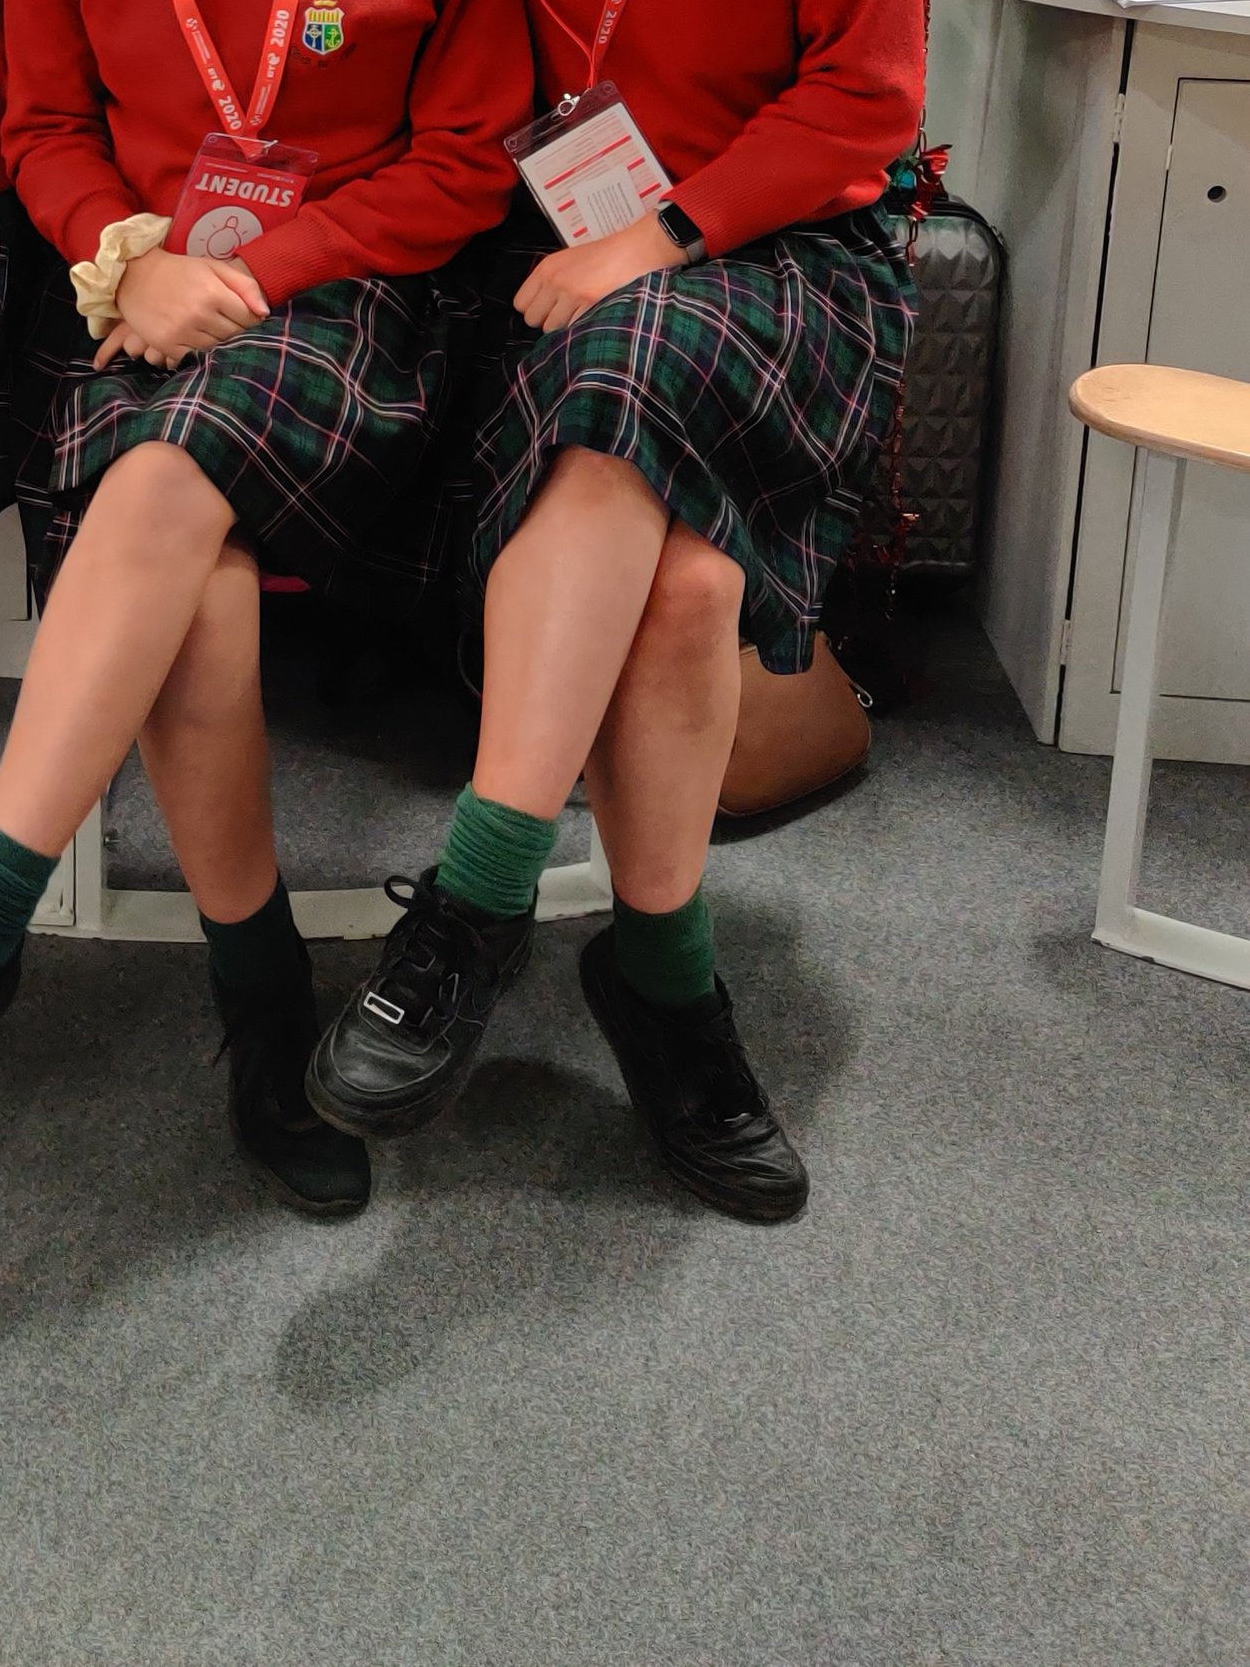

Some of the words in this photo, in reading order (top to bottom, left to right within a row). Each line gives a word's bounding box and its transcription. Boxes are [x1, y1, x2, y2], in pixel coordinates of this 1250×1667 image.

[270, 9, 290, 48] 2020
[598, 10, 617, 45] 2020
[218, 96, 242, 131] 2020
[195, 173, 295, 208] STUDENT
